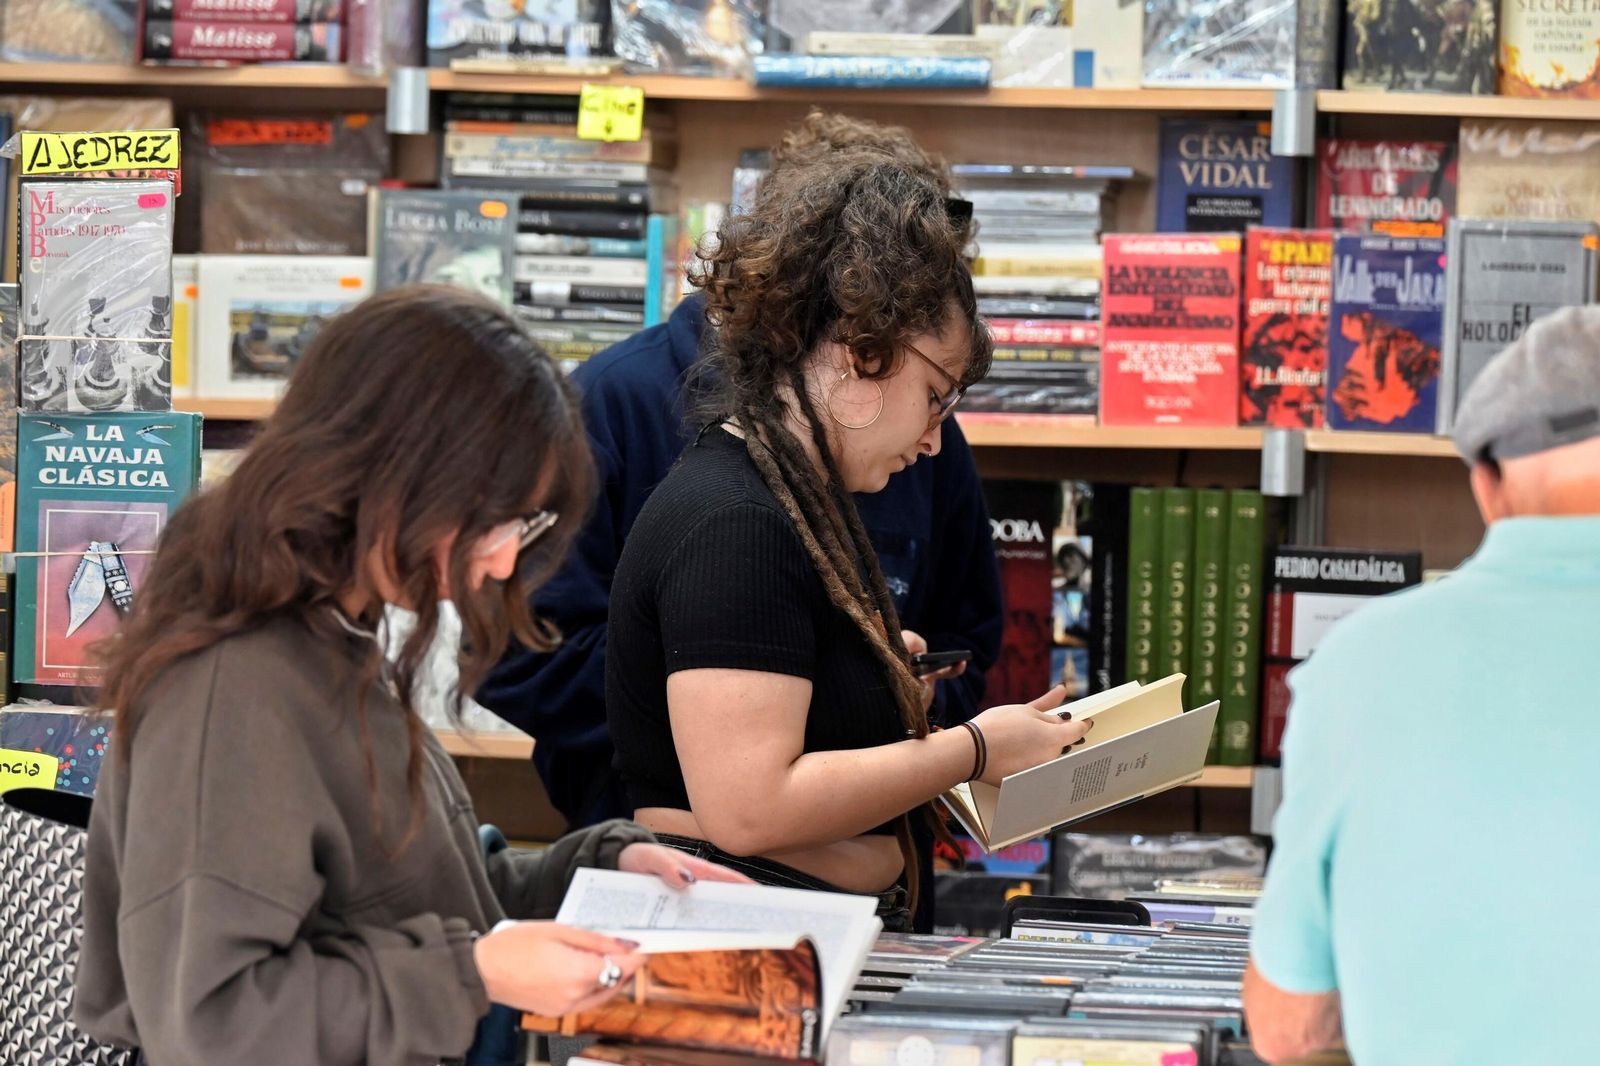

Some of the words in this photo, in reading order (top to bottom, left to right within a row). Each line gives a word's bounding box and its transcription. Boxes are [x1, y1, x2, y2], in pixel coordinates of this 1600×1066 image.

[191, 25, 278, 49] Matisse
[27, 134, 172, 172] AJEDREZ
[1179, 131, 1271, 162] CÉSAR
[1179, 161, 1273, 190] VIDAL
[1371, 171, 1398, 195] DE
[1330, 195, 1443, 221] LENINGRADO
[1249, 299, 1291, 316] guerra
[1512, 303, 1533, 325] EL
[1461, 319, 1514, 343] HOLOC
[86, 425, 125, 442] LA
[45, 445, 164, 465] NAVAJA
[38, 464, 170, 487] CLÁSICA
[1274, 556, 1319, 579] PEDRO
[1319, 555, 1406, 583] CASALDÁLIGA
